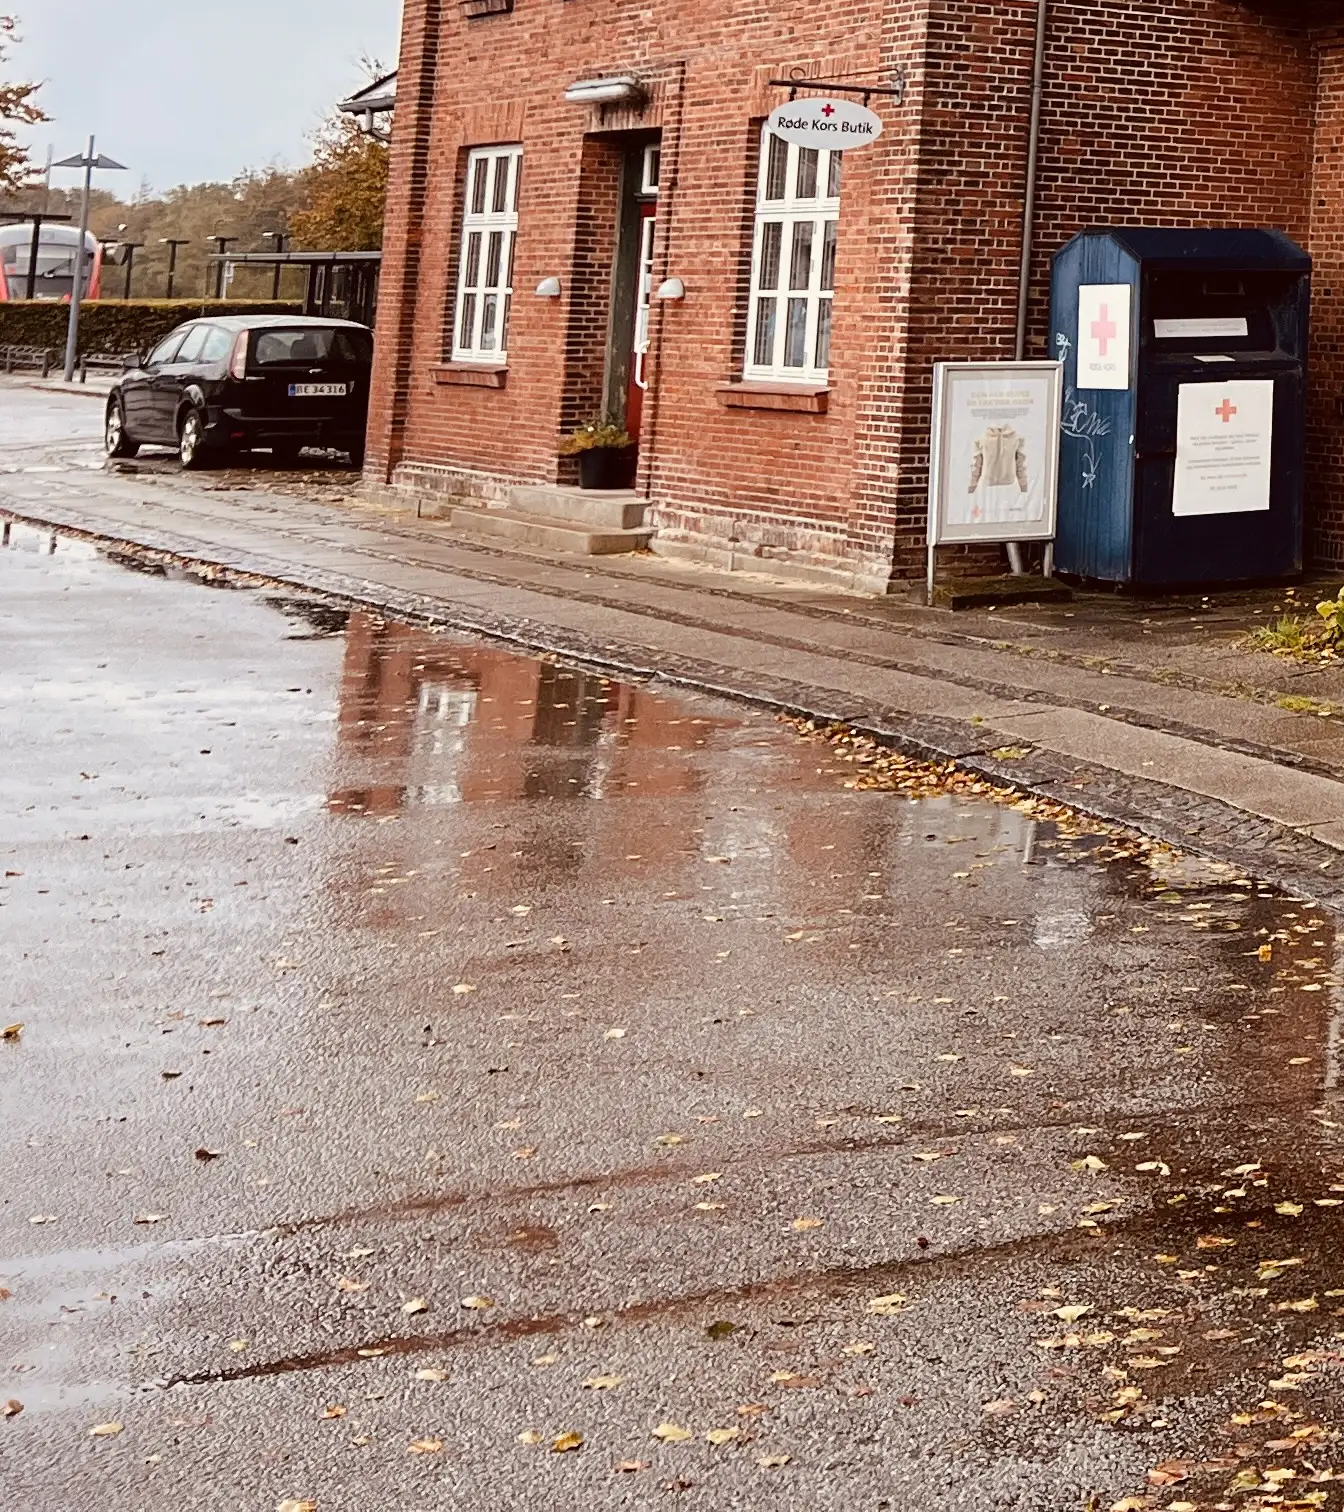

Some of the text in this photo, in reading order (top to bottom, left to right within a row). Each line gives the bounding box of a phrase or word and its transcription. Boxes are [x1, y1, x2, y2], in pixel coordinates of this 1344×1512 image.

[778, 117, 873, 134] Røde Kors Butik
